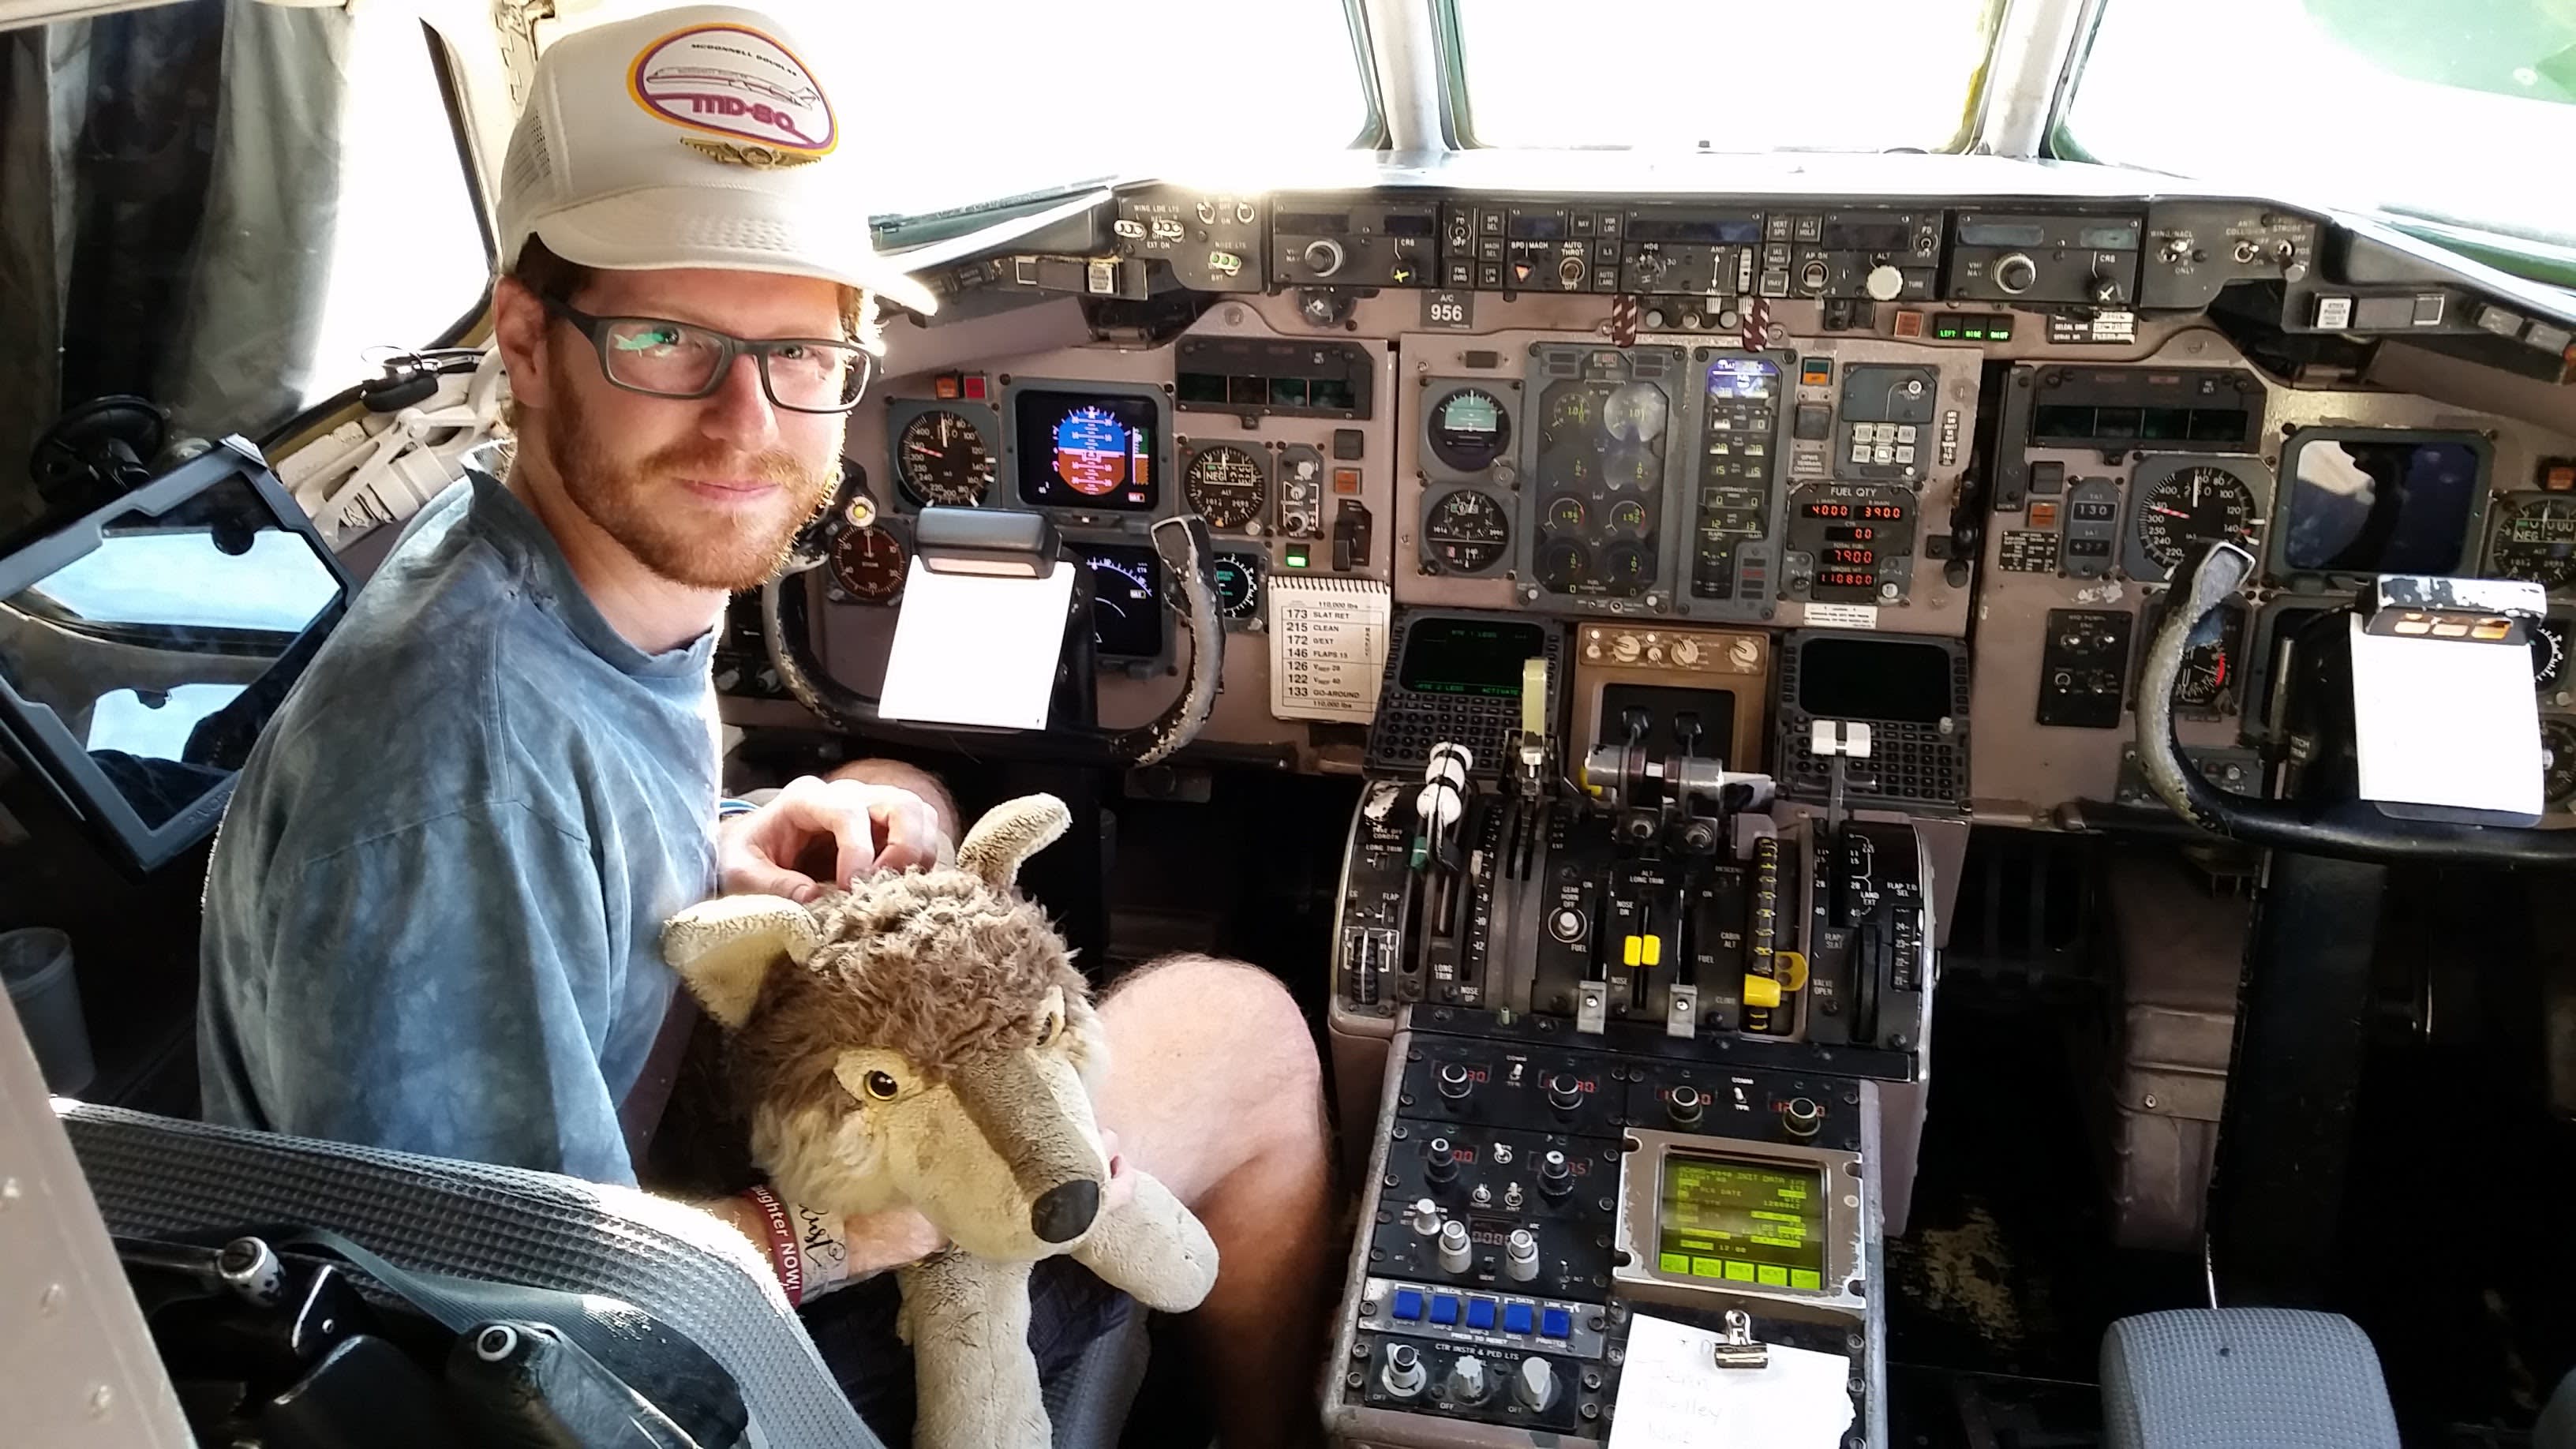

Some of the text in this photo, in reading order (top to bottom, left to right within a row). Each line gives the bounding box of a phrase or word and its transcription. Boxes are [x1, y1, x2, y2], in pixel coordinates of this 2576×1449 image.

[1440, 294, 1455, 302] A/C
[1431, 305, 1463, 321] 956
[1830, 486, 1878, 497] FUEL QTY
[2219, 490, 2234, 499] 100
[1812, 505, 1848, 517] 4000
[1865, 506, 1901, 519] 3900
[2080, 505, 2107, 515] 130
[2226, 506, 2241, 515] 120
[2147, 515, 2164, 523] 300
[2148, 526, 2166, 535] 250
[2224, 524, 2239, 533] 140
[1855, 528, 1872, 540] 00
[1834, 550, 1873, 564] 7900
[1286, 608, 1308, 620] 173
[1286, 622, 1309, 632] 215
[1287, 635, 1309, 645] 172
[1287, 648, 1308, 658] 146
[1287, 661, 1308, 671] 126
[1288, 674, 1309, 684] 122
[1288, 687, 1361, 698] 133 GO-AROUND
[1383, 892, 1400, 900] FLAP
[1616, 900, 1634, 909] NOSE
[1619, 908, 1630, 916] DN
[1571, 944, 1587, 953] FUEL
[1698, 955, 1715, 964] FUEL
[1434, 964, 1453, 973] LONG
[1461, 987, 1478, 995] NOSE
[1515, 1297, 1536, 1305] DATA
[1485, 1336, 1508, 1345] RESET
[1435, 1343, 1451, 1352] CTR
[1452, 1345, 1476, 1355] INSTR
[1486, 1350, 1503, 1358] PED
[1504, 1352, 1520, 1361] LTS
[1440, 1402, 1455, 1410] OFF
